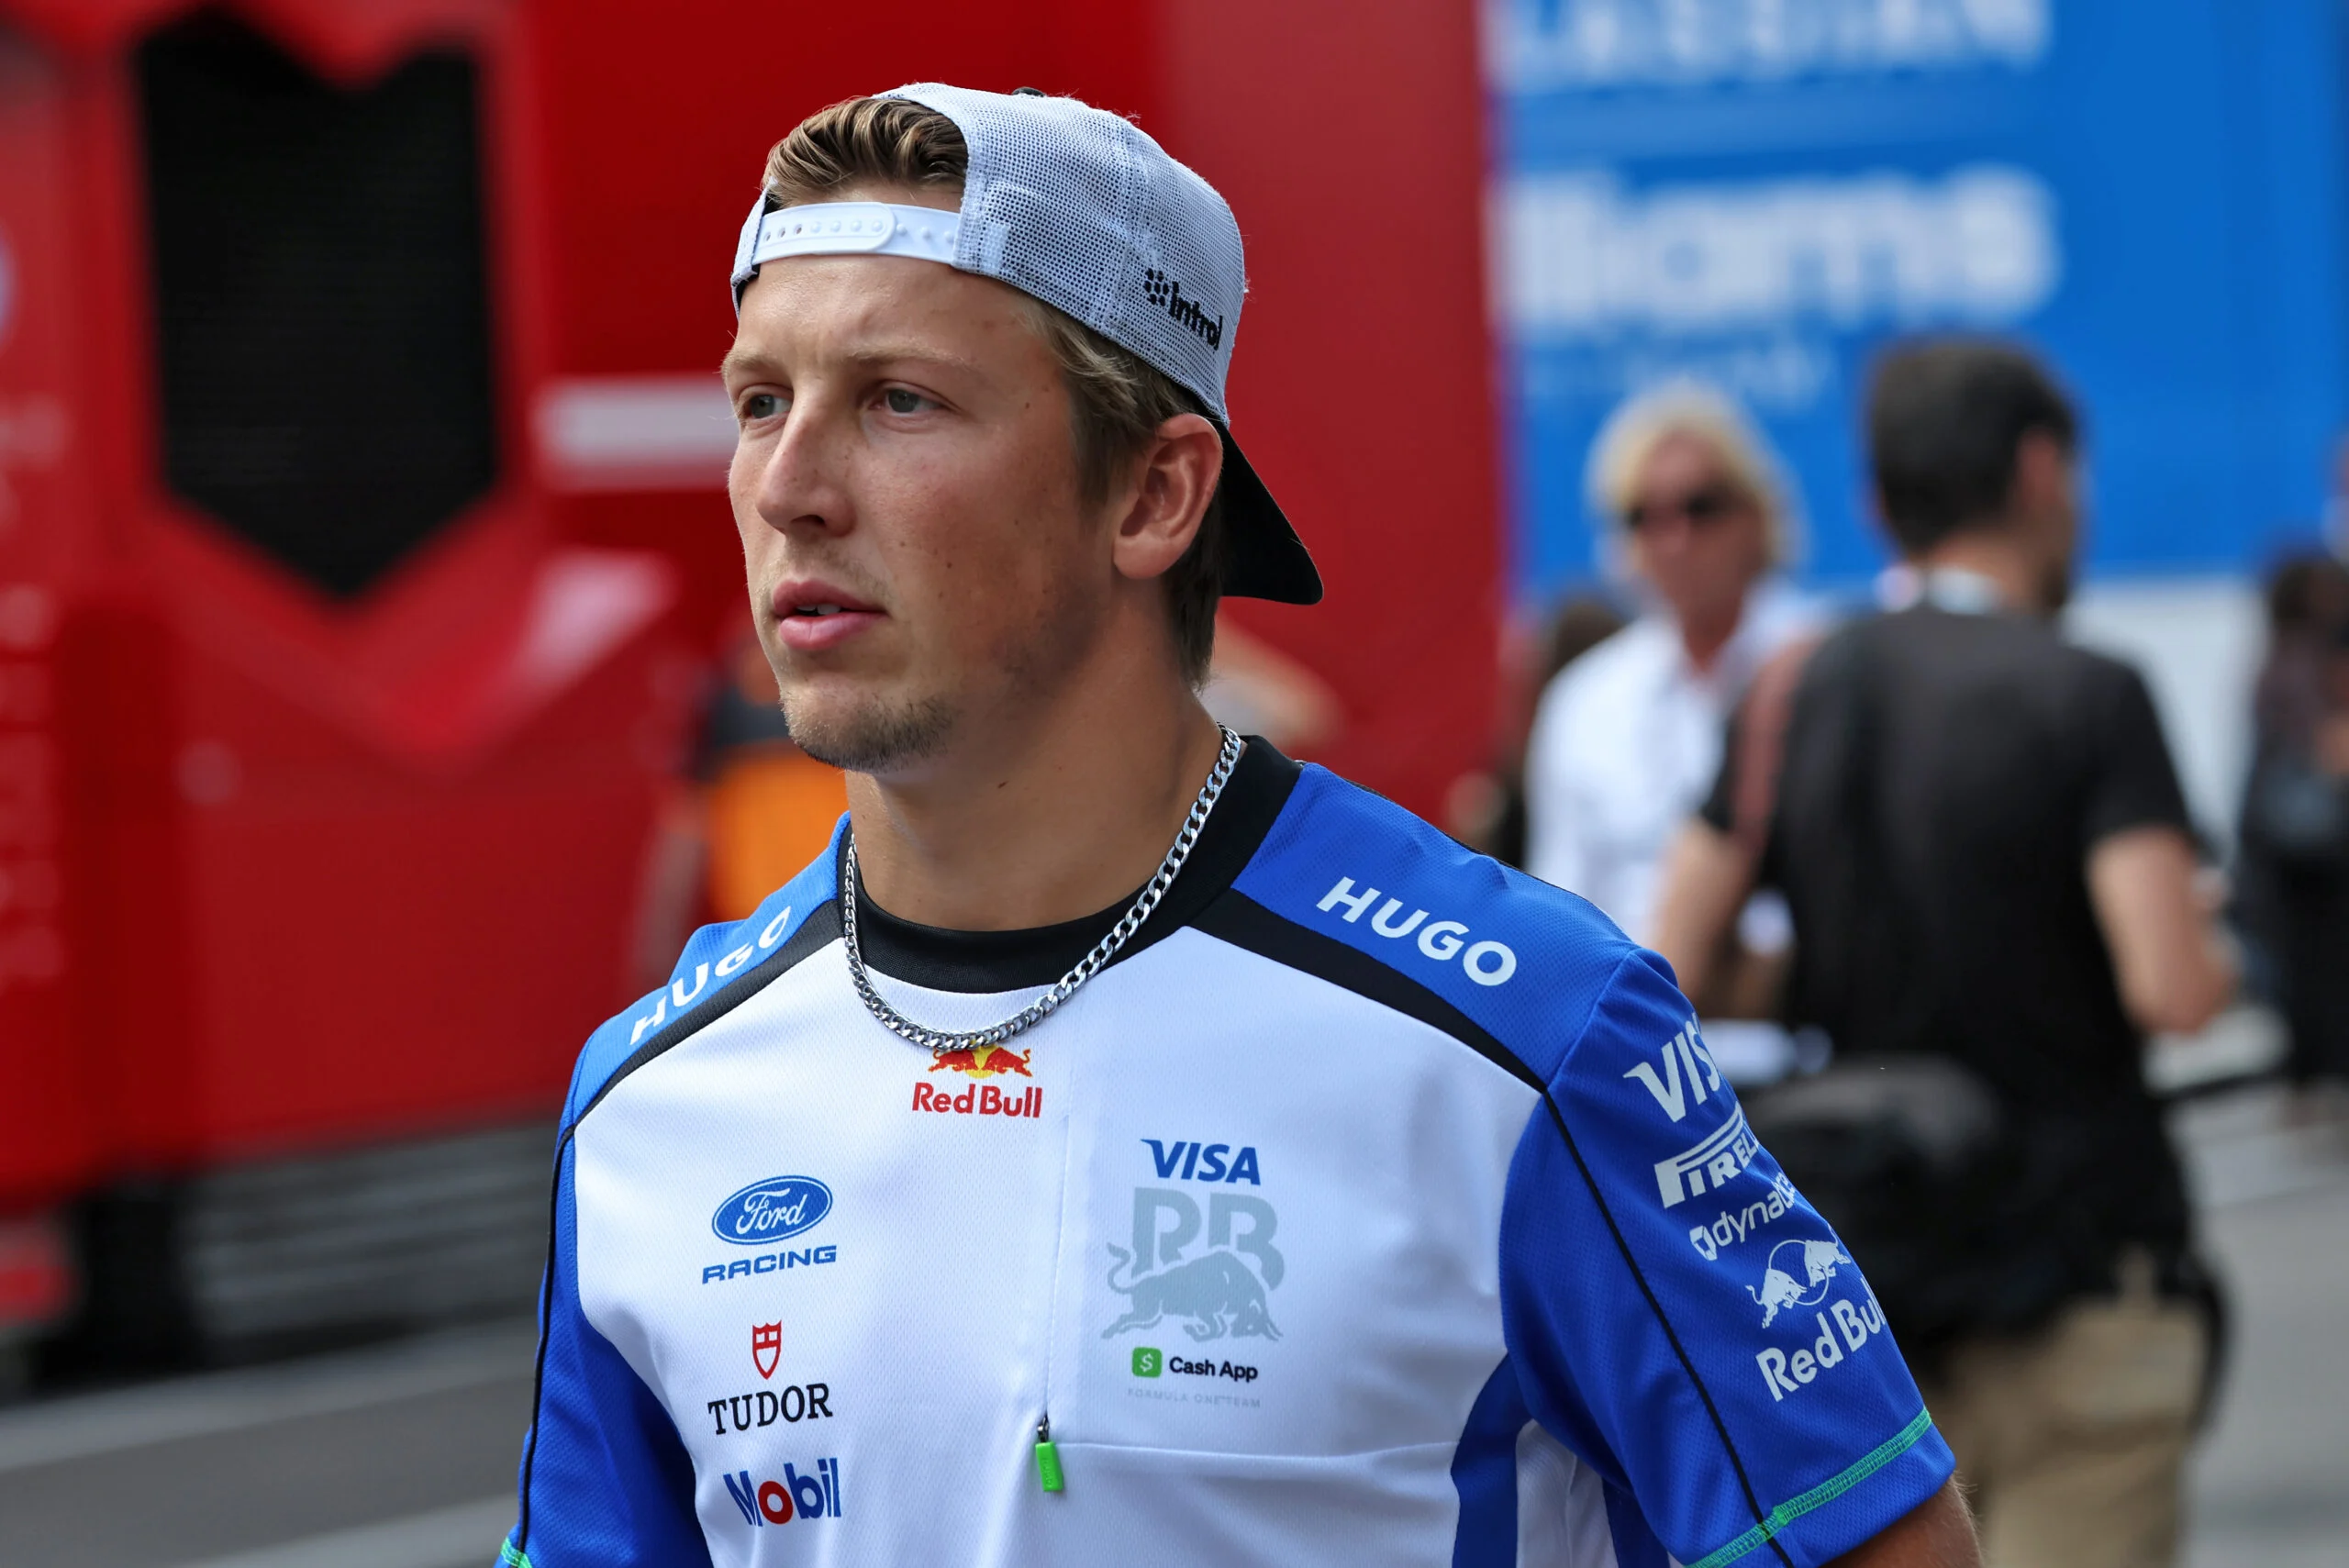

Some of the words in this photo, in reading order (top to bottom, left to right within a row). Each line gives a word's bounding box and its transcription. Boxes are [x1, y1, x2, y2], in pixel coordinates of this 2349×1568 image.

[1316, 876, 1517, 986] HUGO
[629, 906, 791, 1046] HUGO
[912, 1082, 976, 1114] Red
[979, 1085, 1042, 1118] Bull
[1140, 1139, 1261, 1185] VISA
[1653, 1100, 1759, 1209] PIREL
[735, 1187, 807, 1235] Ford
[702, 1245, 837, 1284] RACING
[1169, 1356, 1216, 1376] Cash
[1219, 1360, 1258, 1383] App
[1755, 1311, 1843, 1402] Red
[707, 1383, 833, 1435] TUDOR
[1128, 1387, 1188, 1402] FORMULA
[723, 1457, 841, 1528] Mobil
